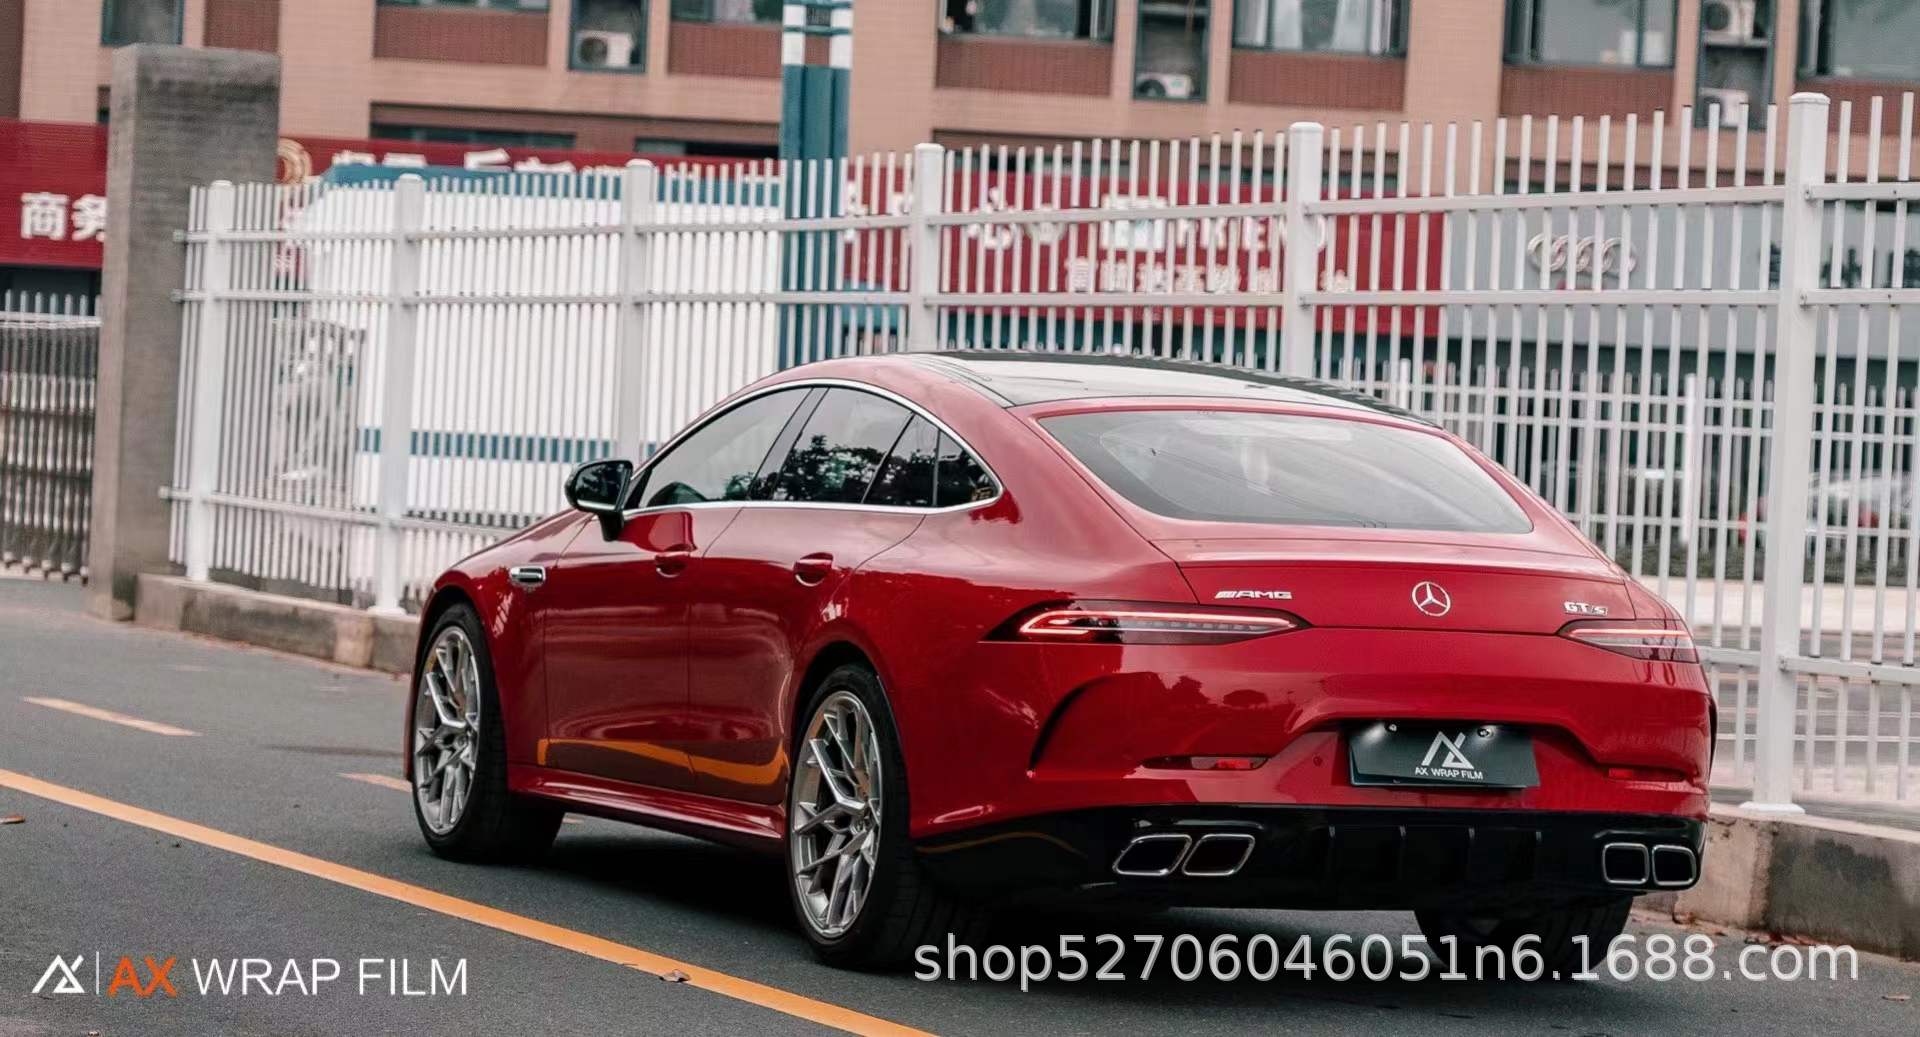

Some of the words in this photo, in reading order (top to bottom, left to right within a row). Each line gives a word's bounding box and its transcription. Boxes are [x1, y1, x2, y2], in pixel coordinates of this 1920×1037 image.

[1234, 590, 1293, 600] AMG
[1415, 767, 1429, 776] AX
[1431, 768, 1460, 777] WRAP
[1462, 770, 1483, 780] FILM
